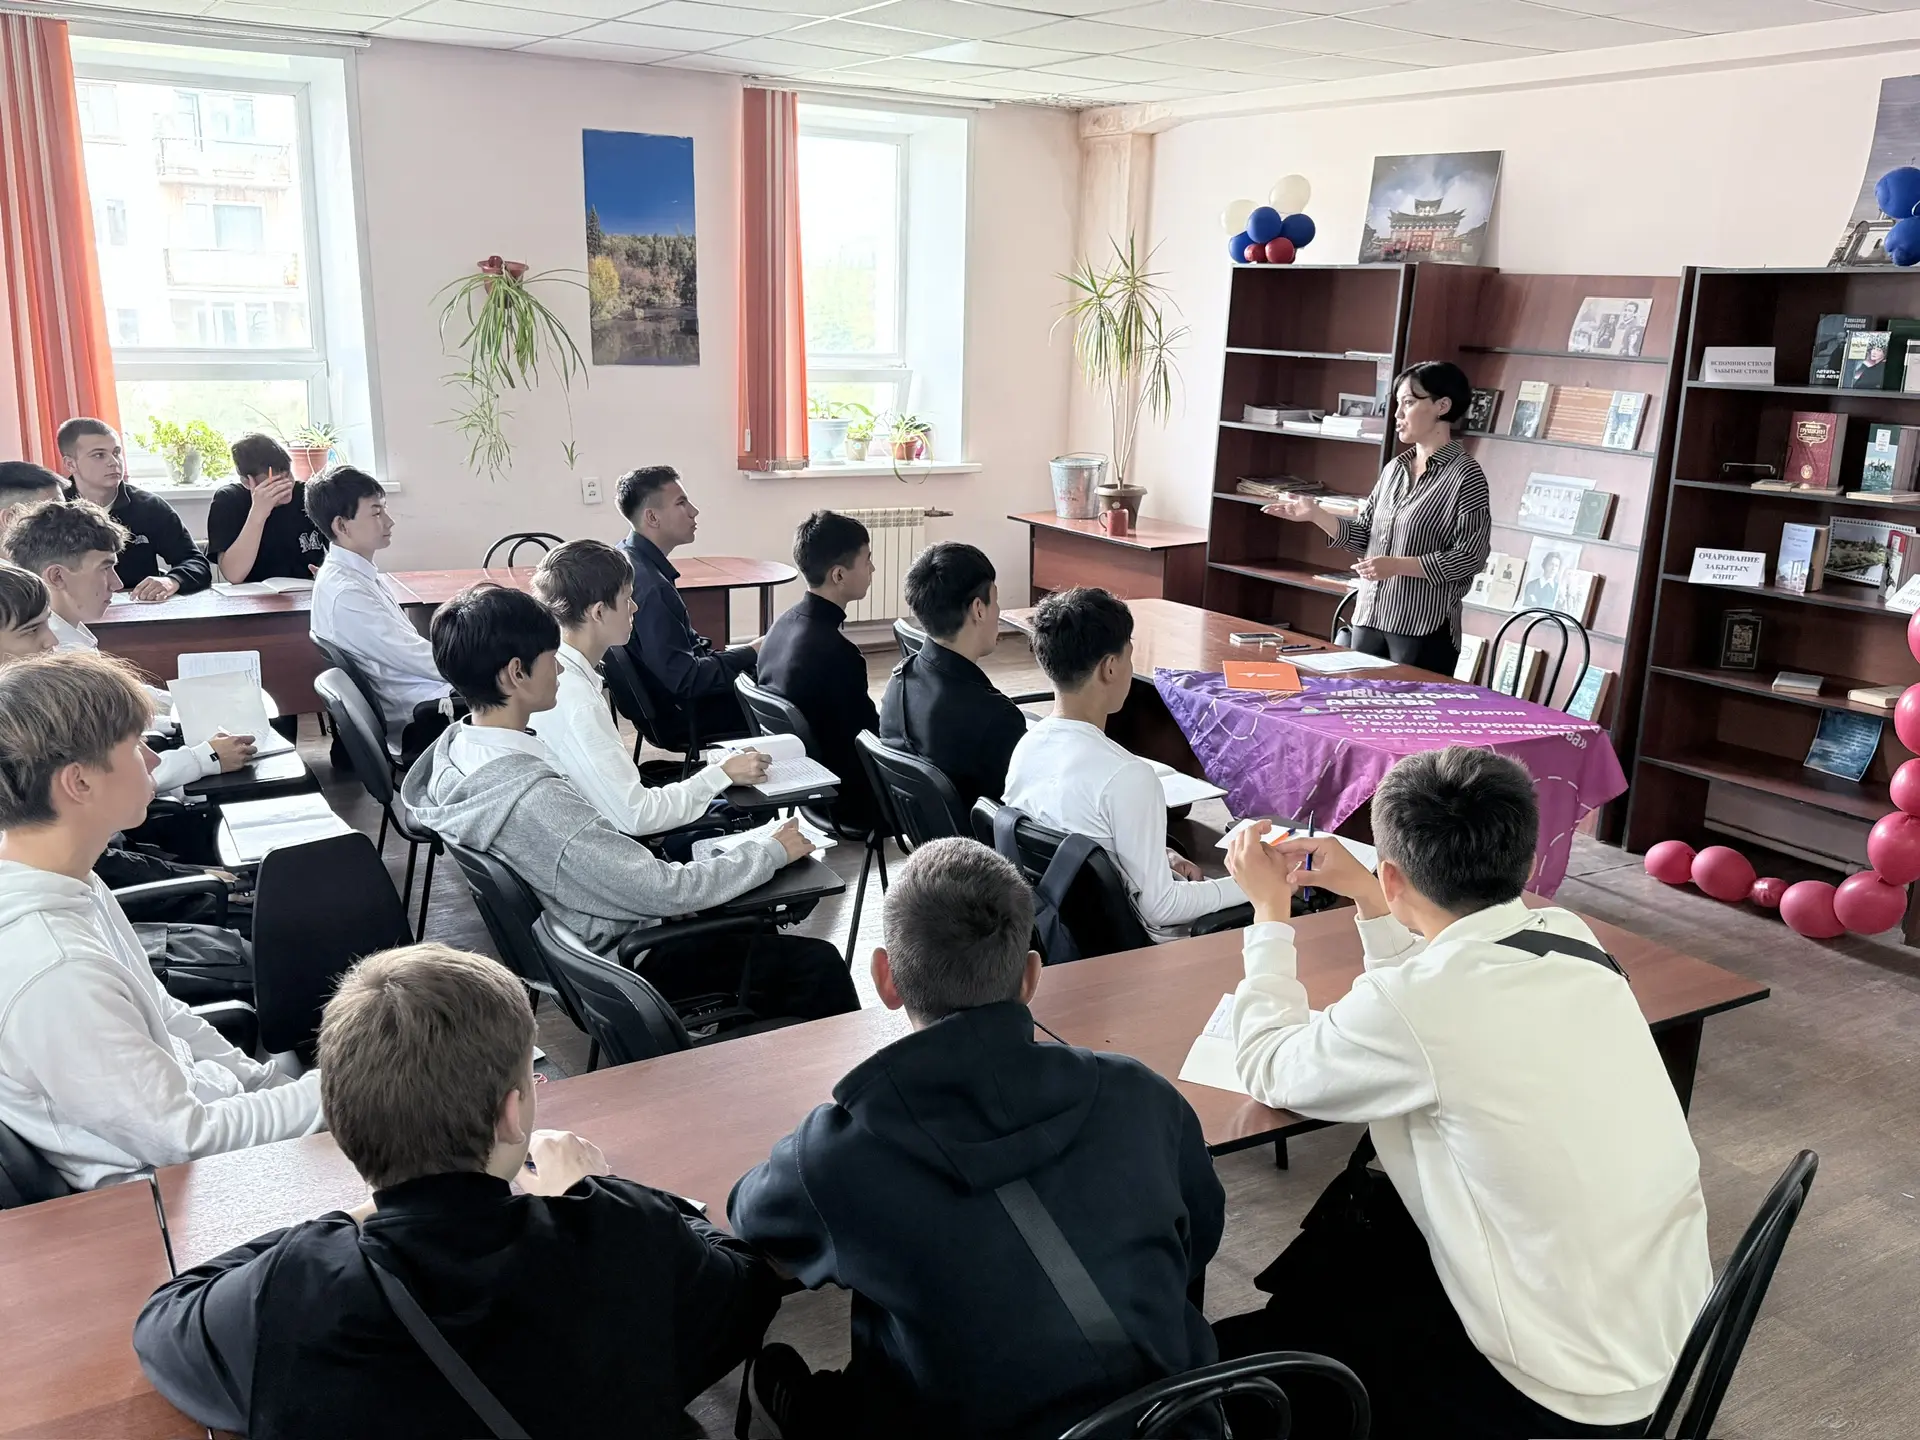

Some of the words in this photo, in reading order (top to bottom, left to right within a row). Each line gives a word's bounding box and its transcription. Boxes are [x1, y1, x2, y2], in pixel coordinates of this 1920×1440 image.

[1698, 552, 1760, 563] ОЧАРОВАНИЕ
[1705, 563, 1750, 572] ЗАБЫТЫХ
[1345, 719, 1455, 728] «Техникум
[1460, 721, 1602, 734] строительства
